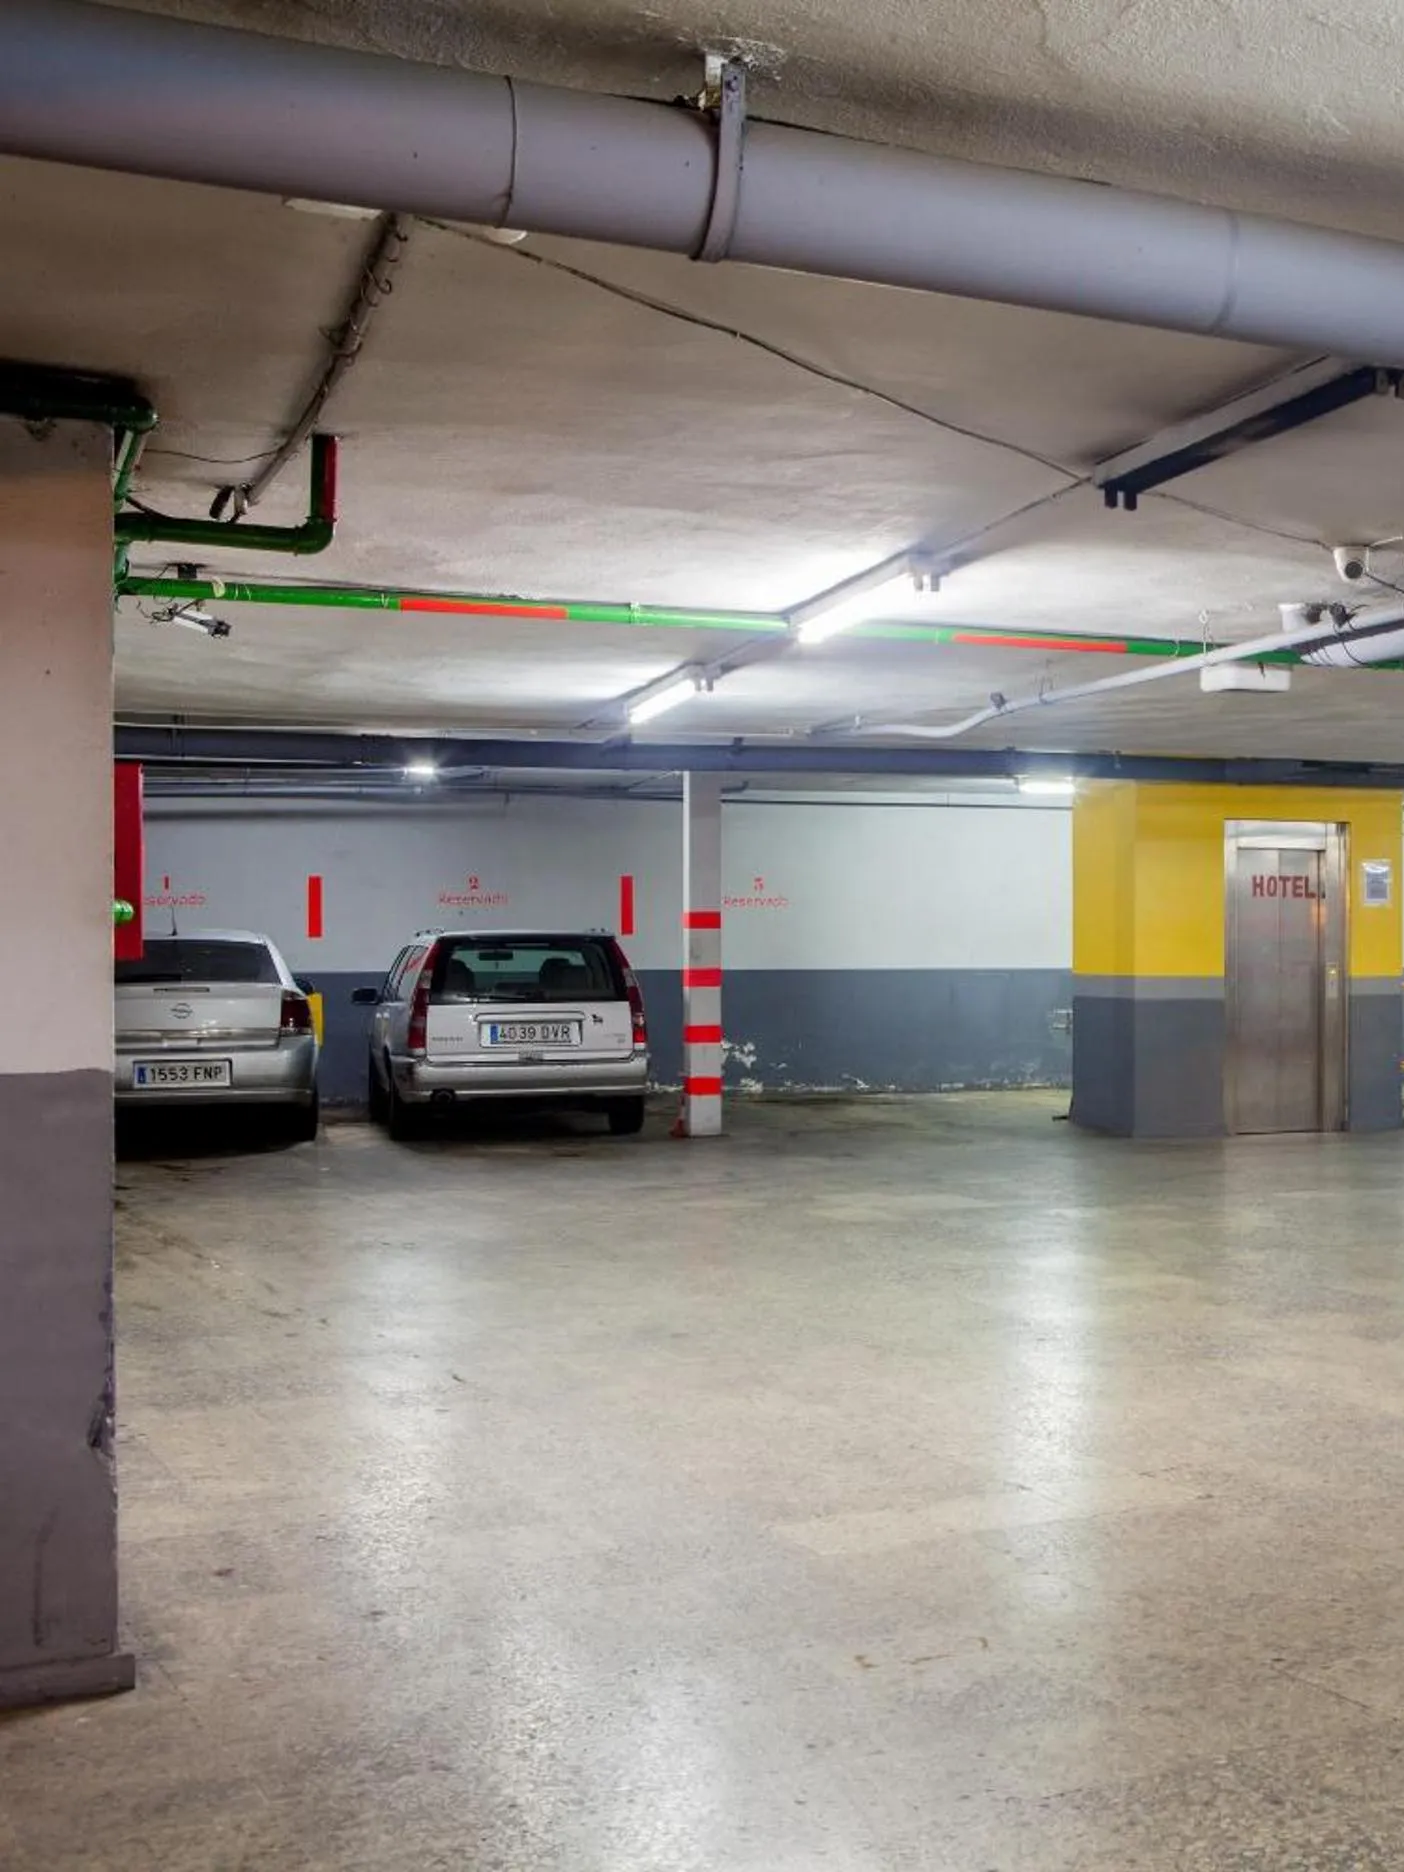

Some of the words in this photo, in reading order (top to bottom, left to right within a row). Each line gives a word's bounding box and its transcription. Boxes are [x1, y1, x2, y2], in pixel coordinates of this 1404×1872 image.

[1251, 874, 1317, 900] HOTEL
[150, 1065, 188, 1081] 1553
[193, 1065, 222, 1081] FNP
